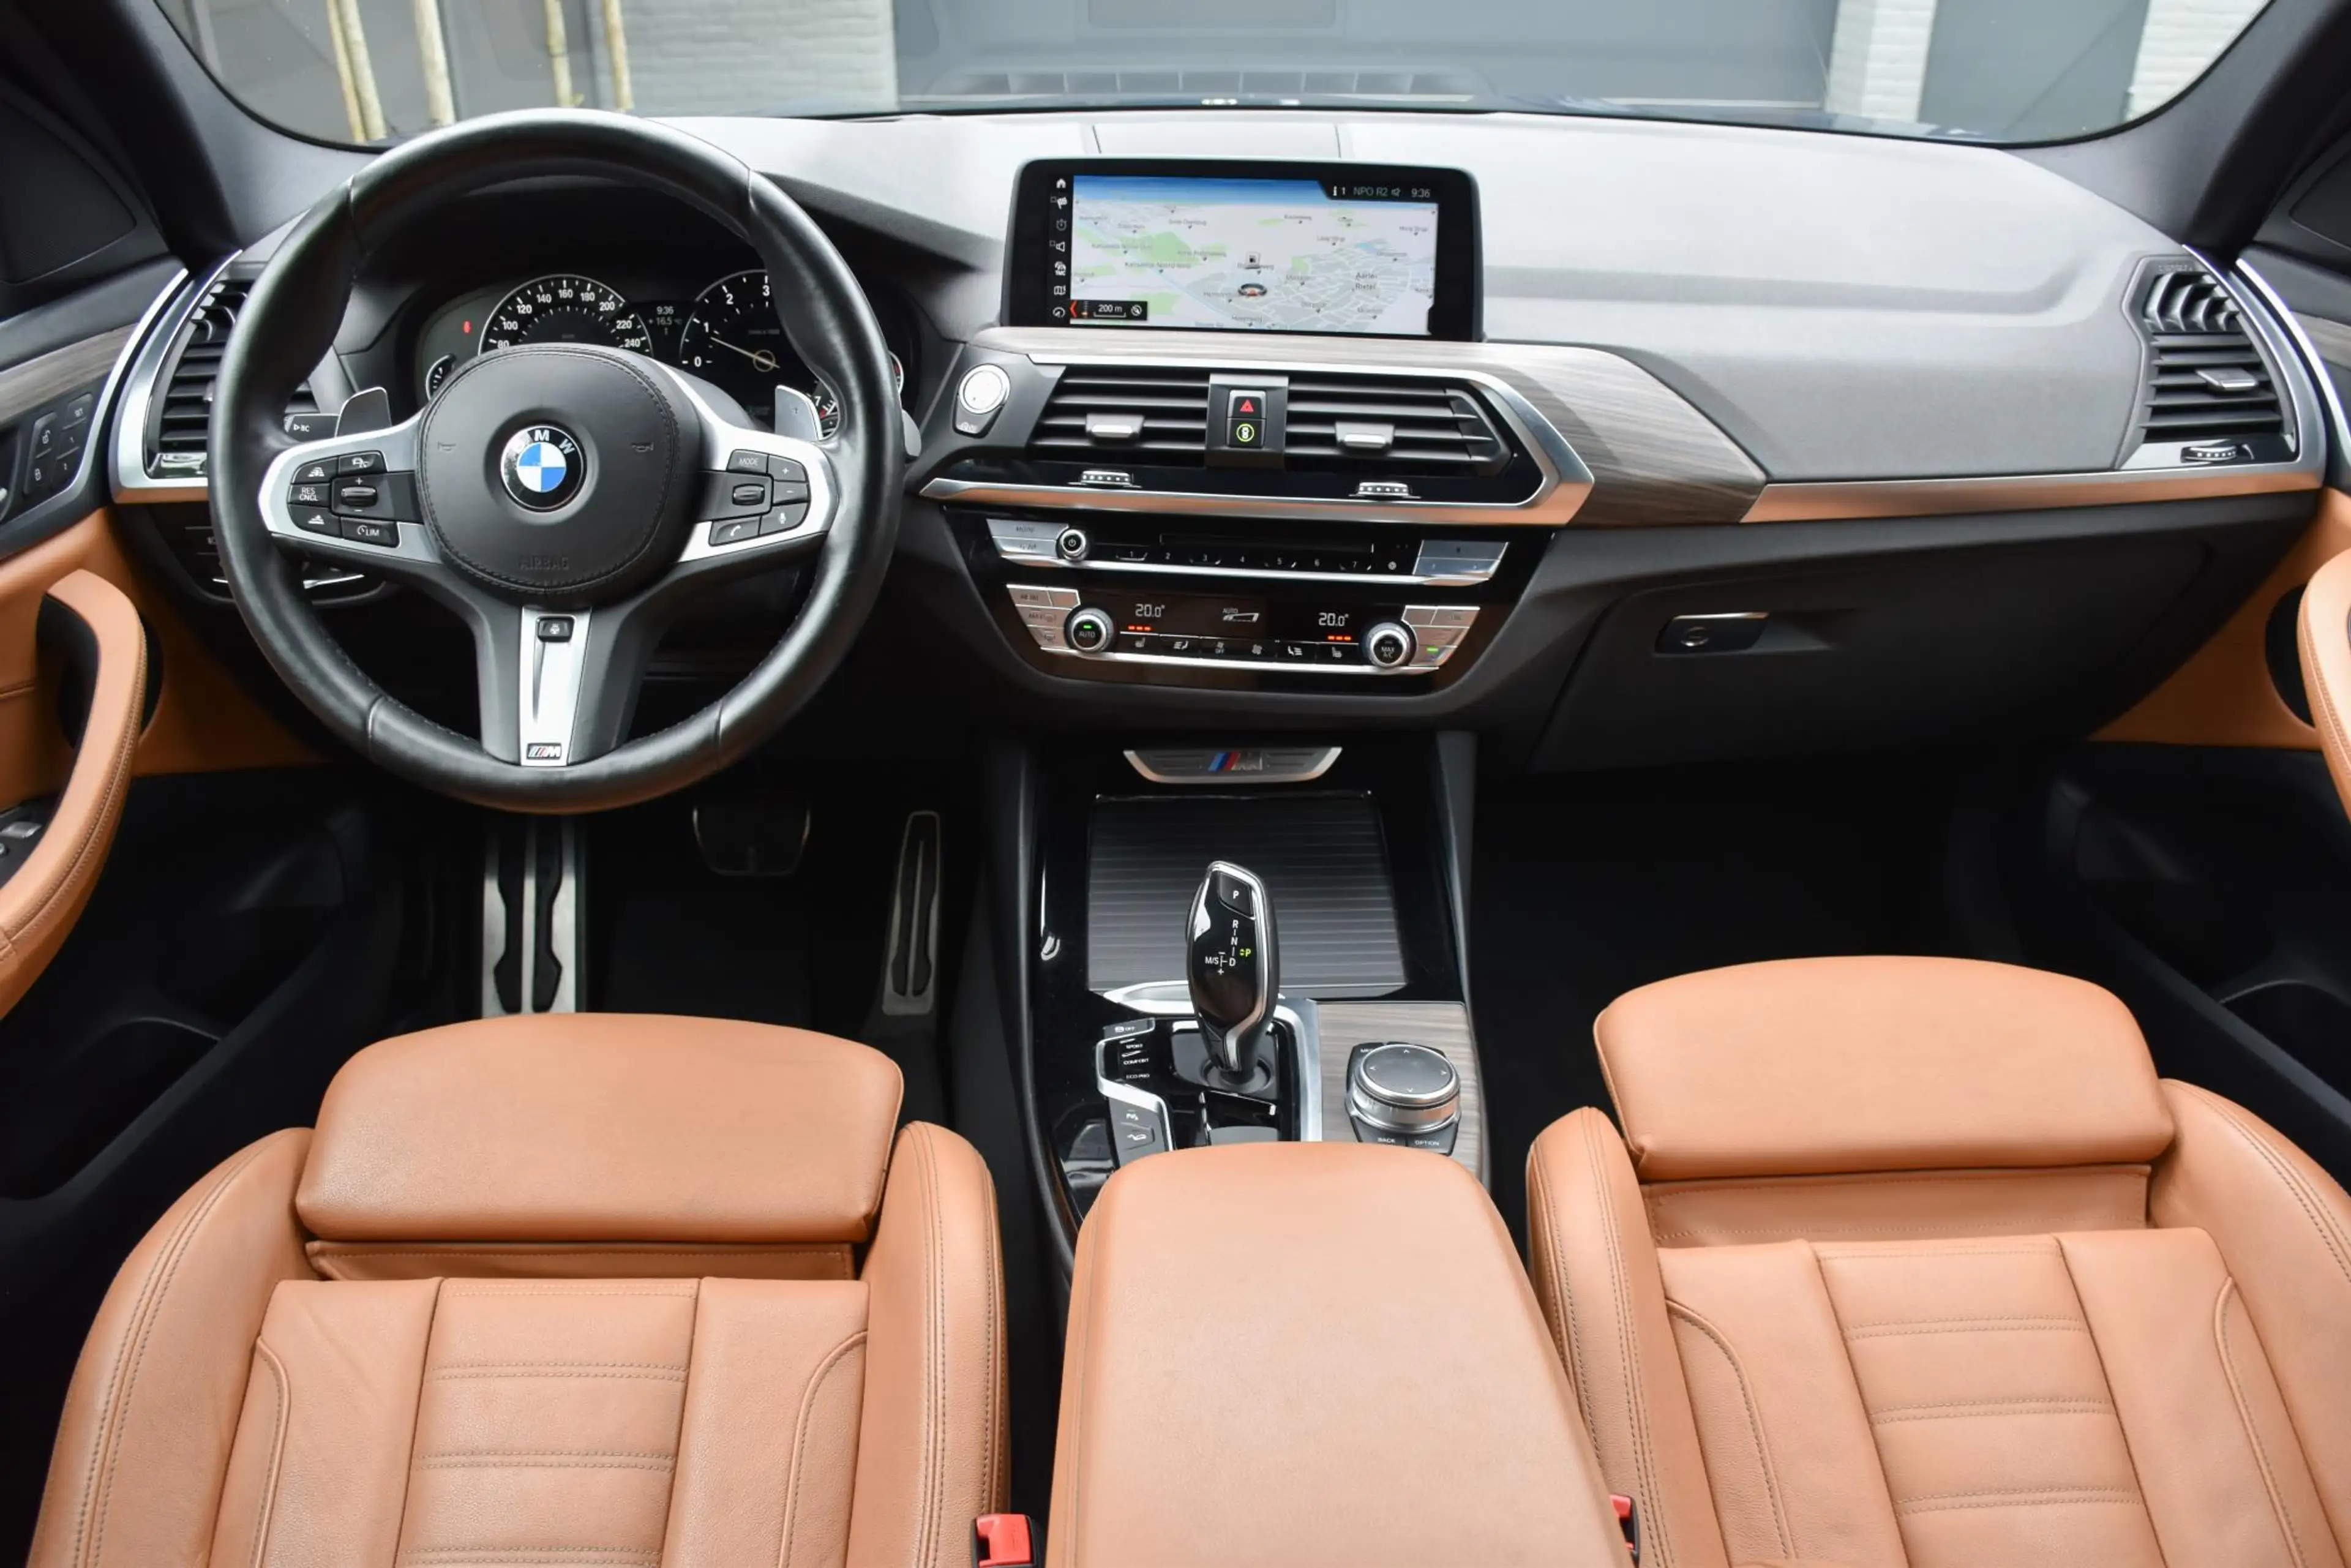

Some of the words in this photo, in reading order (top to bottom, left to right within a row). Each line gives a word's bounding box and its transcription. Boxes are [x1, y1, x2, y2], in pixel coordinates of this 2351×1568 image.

[1353, 186, 1374, 196] NPO
[1376, 187, 1389, 196] R2
[1411, 188, 1431, 198] 9:36
[558, 289, 573, 299] 160
[762, 285, 770, 296] 3
[536, 293, 552, 304] 140
[580, 291, 596, 301] 180
[726, 293, 733, 304] 2
[517, 304, 532, 314] 120
[599, 301, 615, 311] 200
[656, 306, 674, 315] 9:36
[502, 321, 518, 331] 100
[617, 320, 632, 329] 220
[703, 321, 710, 332] 1
[624, 339, 640, 348] 240
[694, 356, 702, 367] 0
[814, 396, 822, 406] 7
[738, 457, 760, 466] MODE
[1202, 553, 1208, 562] 3
[1232, 890, 1239, 899] P
[1232, 919, 1239, 928] R
[1231, 937, 1237, 945] N
[1205, 956, 1219, 965] M/S
[1229, 958, 1236, 967] D
